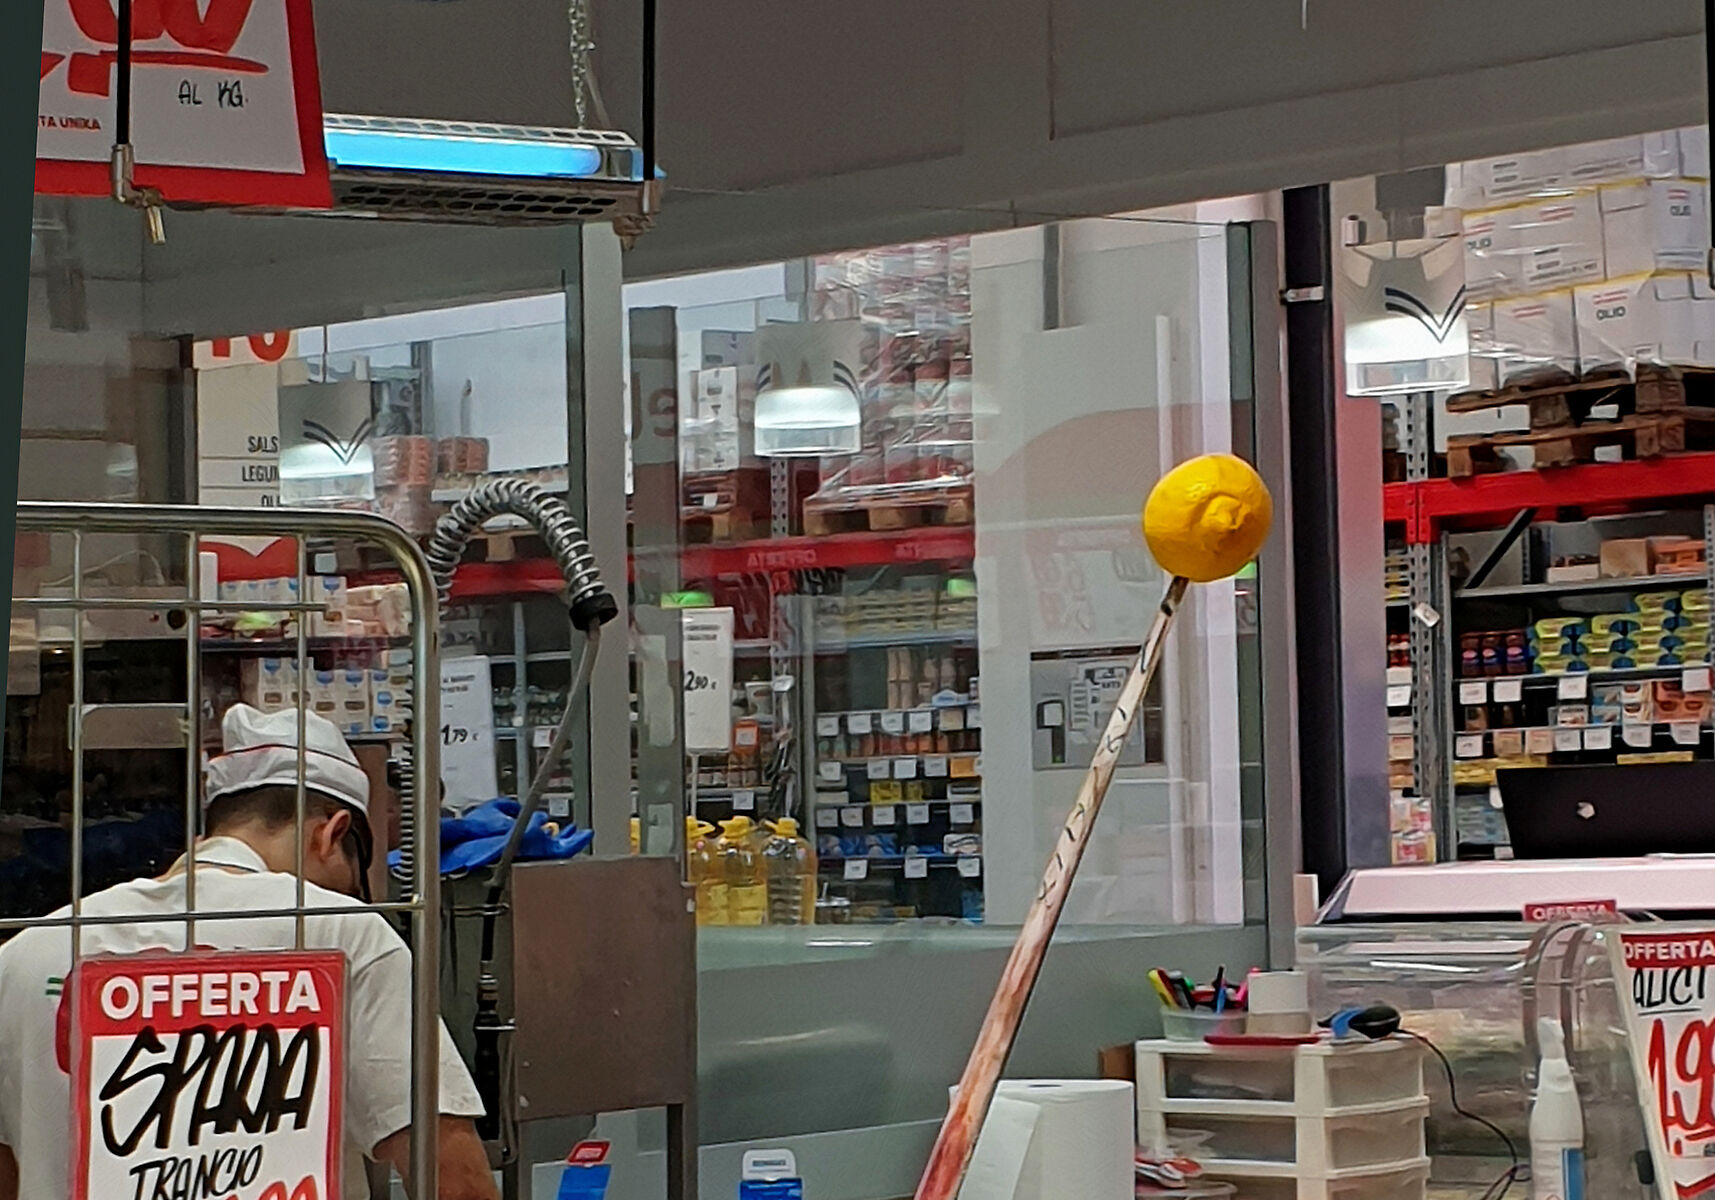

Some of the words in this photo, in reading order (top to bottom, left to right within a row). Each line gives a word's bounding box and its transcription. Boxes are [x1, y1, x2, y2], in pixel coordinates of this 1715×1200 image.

[178, 80, 202, 105] AL
[101, 970, 321, 1020] OFFERTA
[99, 1022, 321, 1157] SPADA
